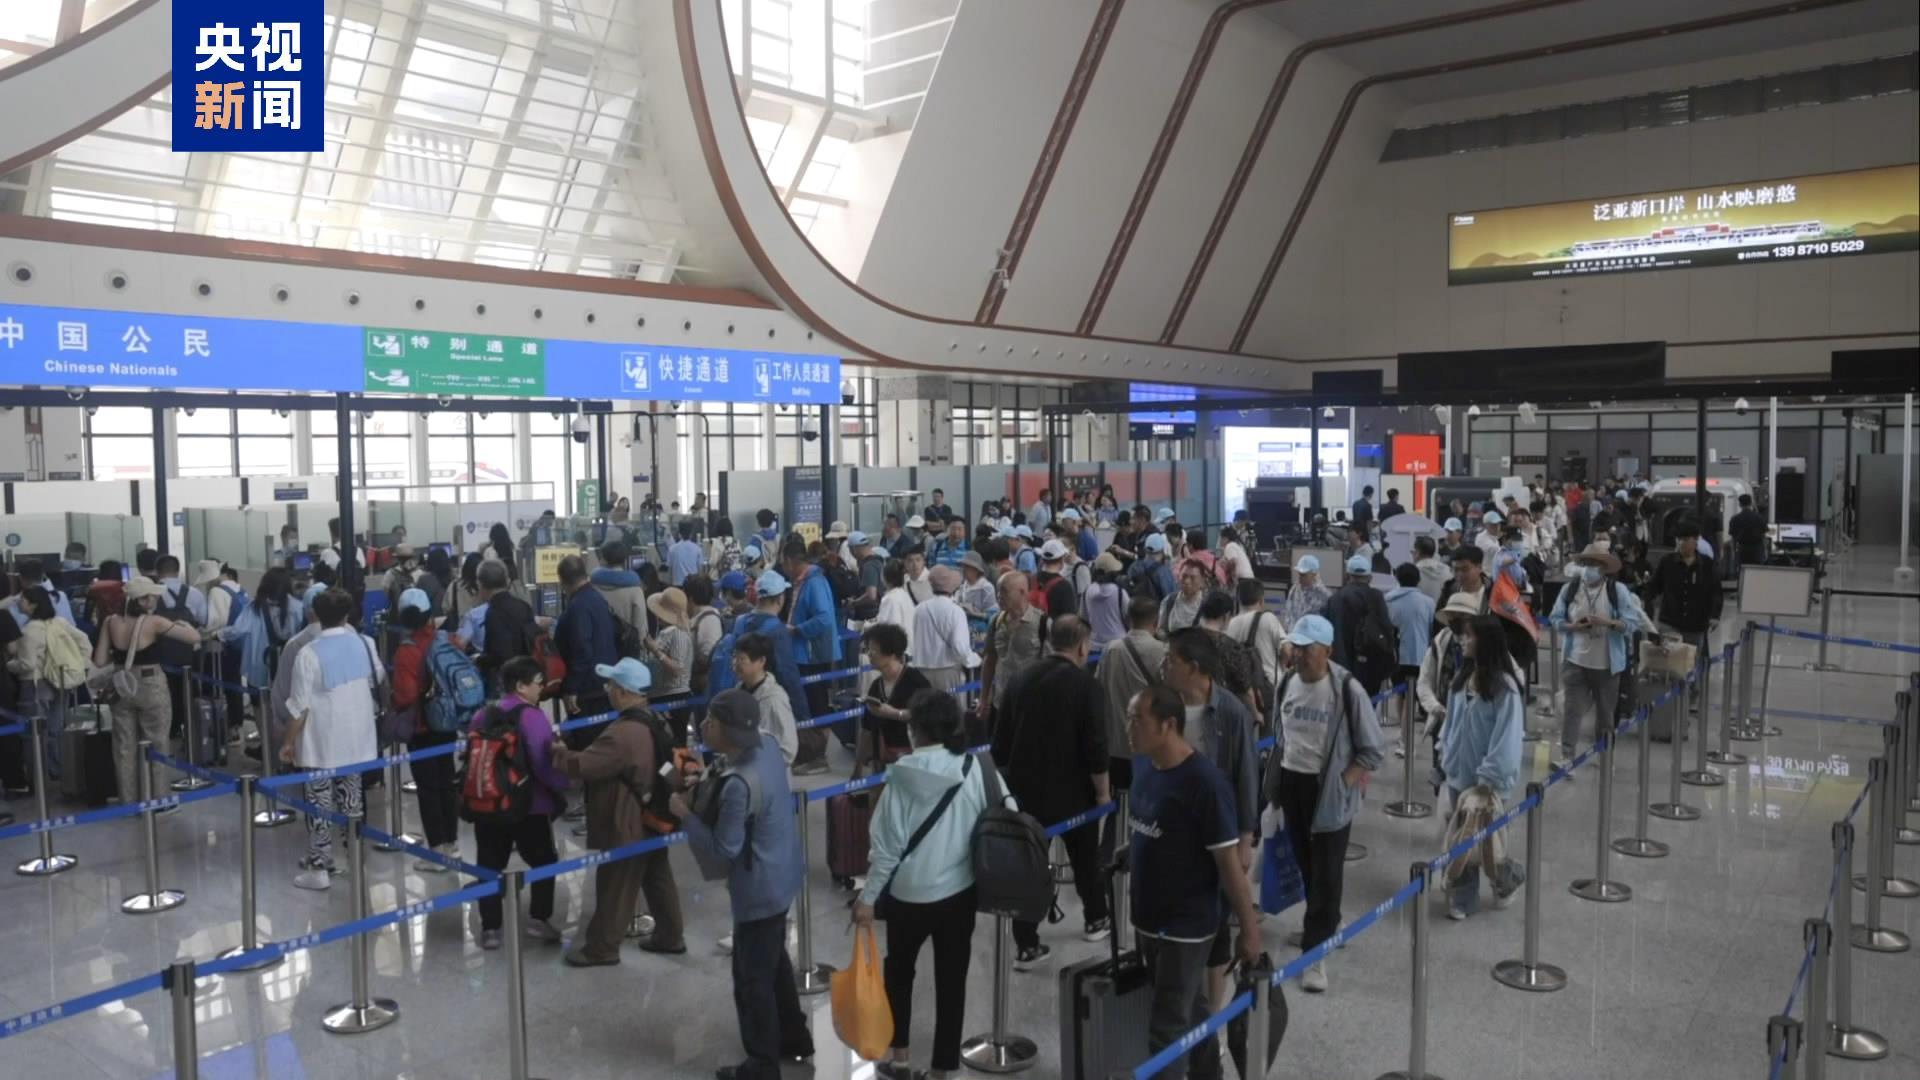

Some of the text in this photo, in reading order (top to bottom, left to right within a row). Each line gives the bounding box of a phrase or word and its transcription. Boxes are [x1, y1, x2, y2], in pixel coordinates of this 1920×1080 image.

[1593, 183, 1796, 221] 泛亚新口岸 山水映磨憨
[1772, 246, 1795, 257] 139
[1797, 243, 1828, 255] 8710
[1830, 240, 1864, 253] 5029
[0, 316, 211, 357] 中国公民
[410, 335, 539, 356] 特别通道
[44, 359, 178, 377] Chinese Nationals
[658, 353, 730, 383] 快捷通道
[772, 361, 831, 384] 工作人员通道
